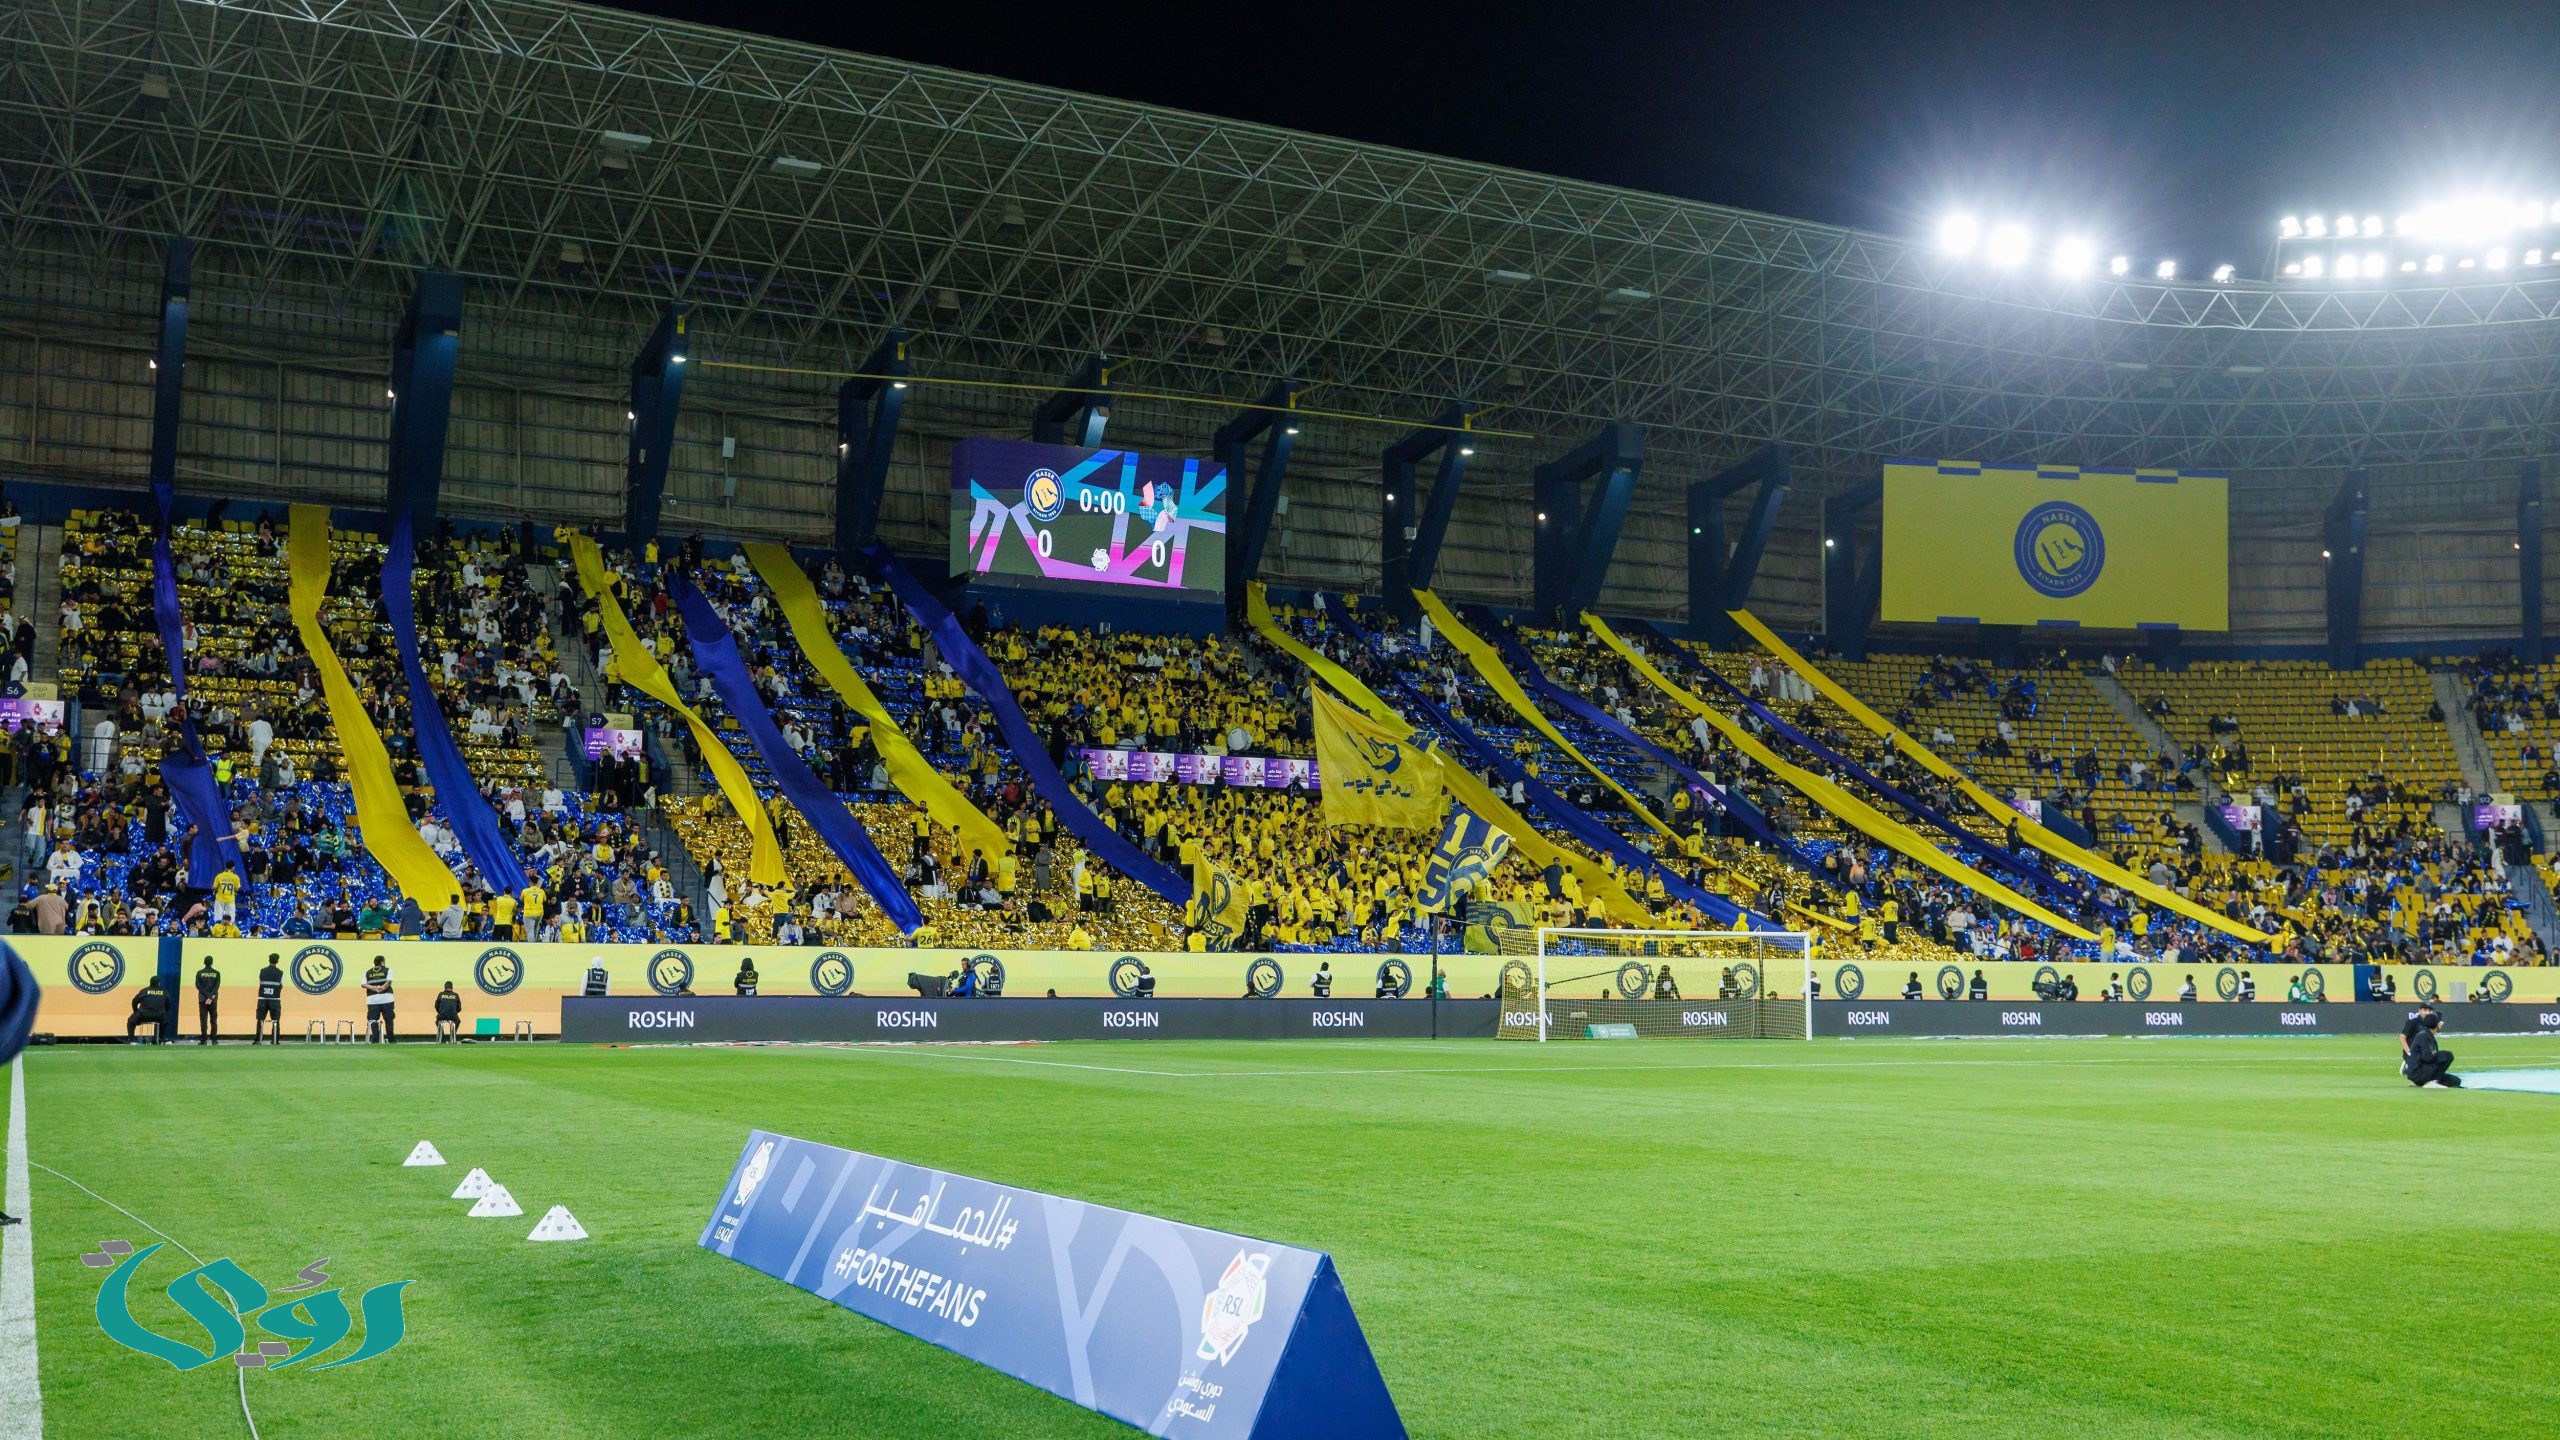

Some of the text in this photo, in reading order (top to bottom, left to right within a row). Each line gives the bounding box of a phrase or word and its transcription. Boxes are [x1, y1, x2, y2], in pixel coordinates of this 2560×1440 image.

[1080, 488, 1125, 515] 0:00
[2041, 513, 2077, 526] NASSR
[1037, 529, 1053, 558] 0
[1151, 540, 1166, 568] 0
[6, 686, 19, 695] S6
[591, 717, 602, 725] S7
[1469, 849, 1490, 861] NASSR
[222, 883, 233, 895] 79
[533, 893, 539, 904] 7
[920, 935, 933, 945] 26
[84, 945, 111, 953] NASSR
[306, 948, 330, 956] NASSR
[822, 954, 843, 962] NASSR
[975, 956, 995, 964] NASSR
[629, 1011, 694, 1028] ROSHN
[877, 1011, 937, 1027] ROSHN
[1103, 1011, 1158, 1027] ROSHN
[1312, 1011, 1363, 1027] ROSHN
[1683, 1011, 1727, 1025] ROSHN
[1848, 1011, 1889, 1025] ROSHN
[2002, 1011, 2041, 1025] ROSHN
[2145, 1012, 2182, 1025] ROSHN
[2281, 1012, 2316, 1025] ROSHN
[2540, 1013, 2560, 1025] RO
[834, 1247, 987, 1328] #FORTHEFANS
[1222, 1294, 1244, 1317] RSL
[1166, 1398, 1216, 1423] السعودي
